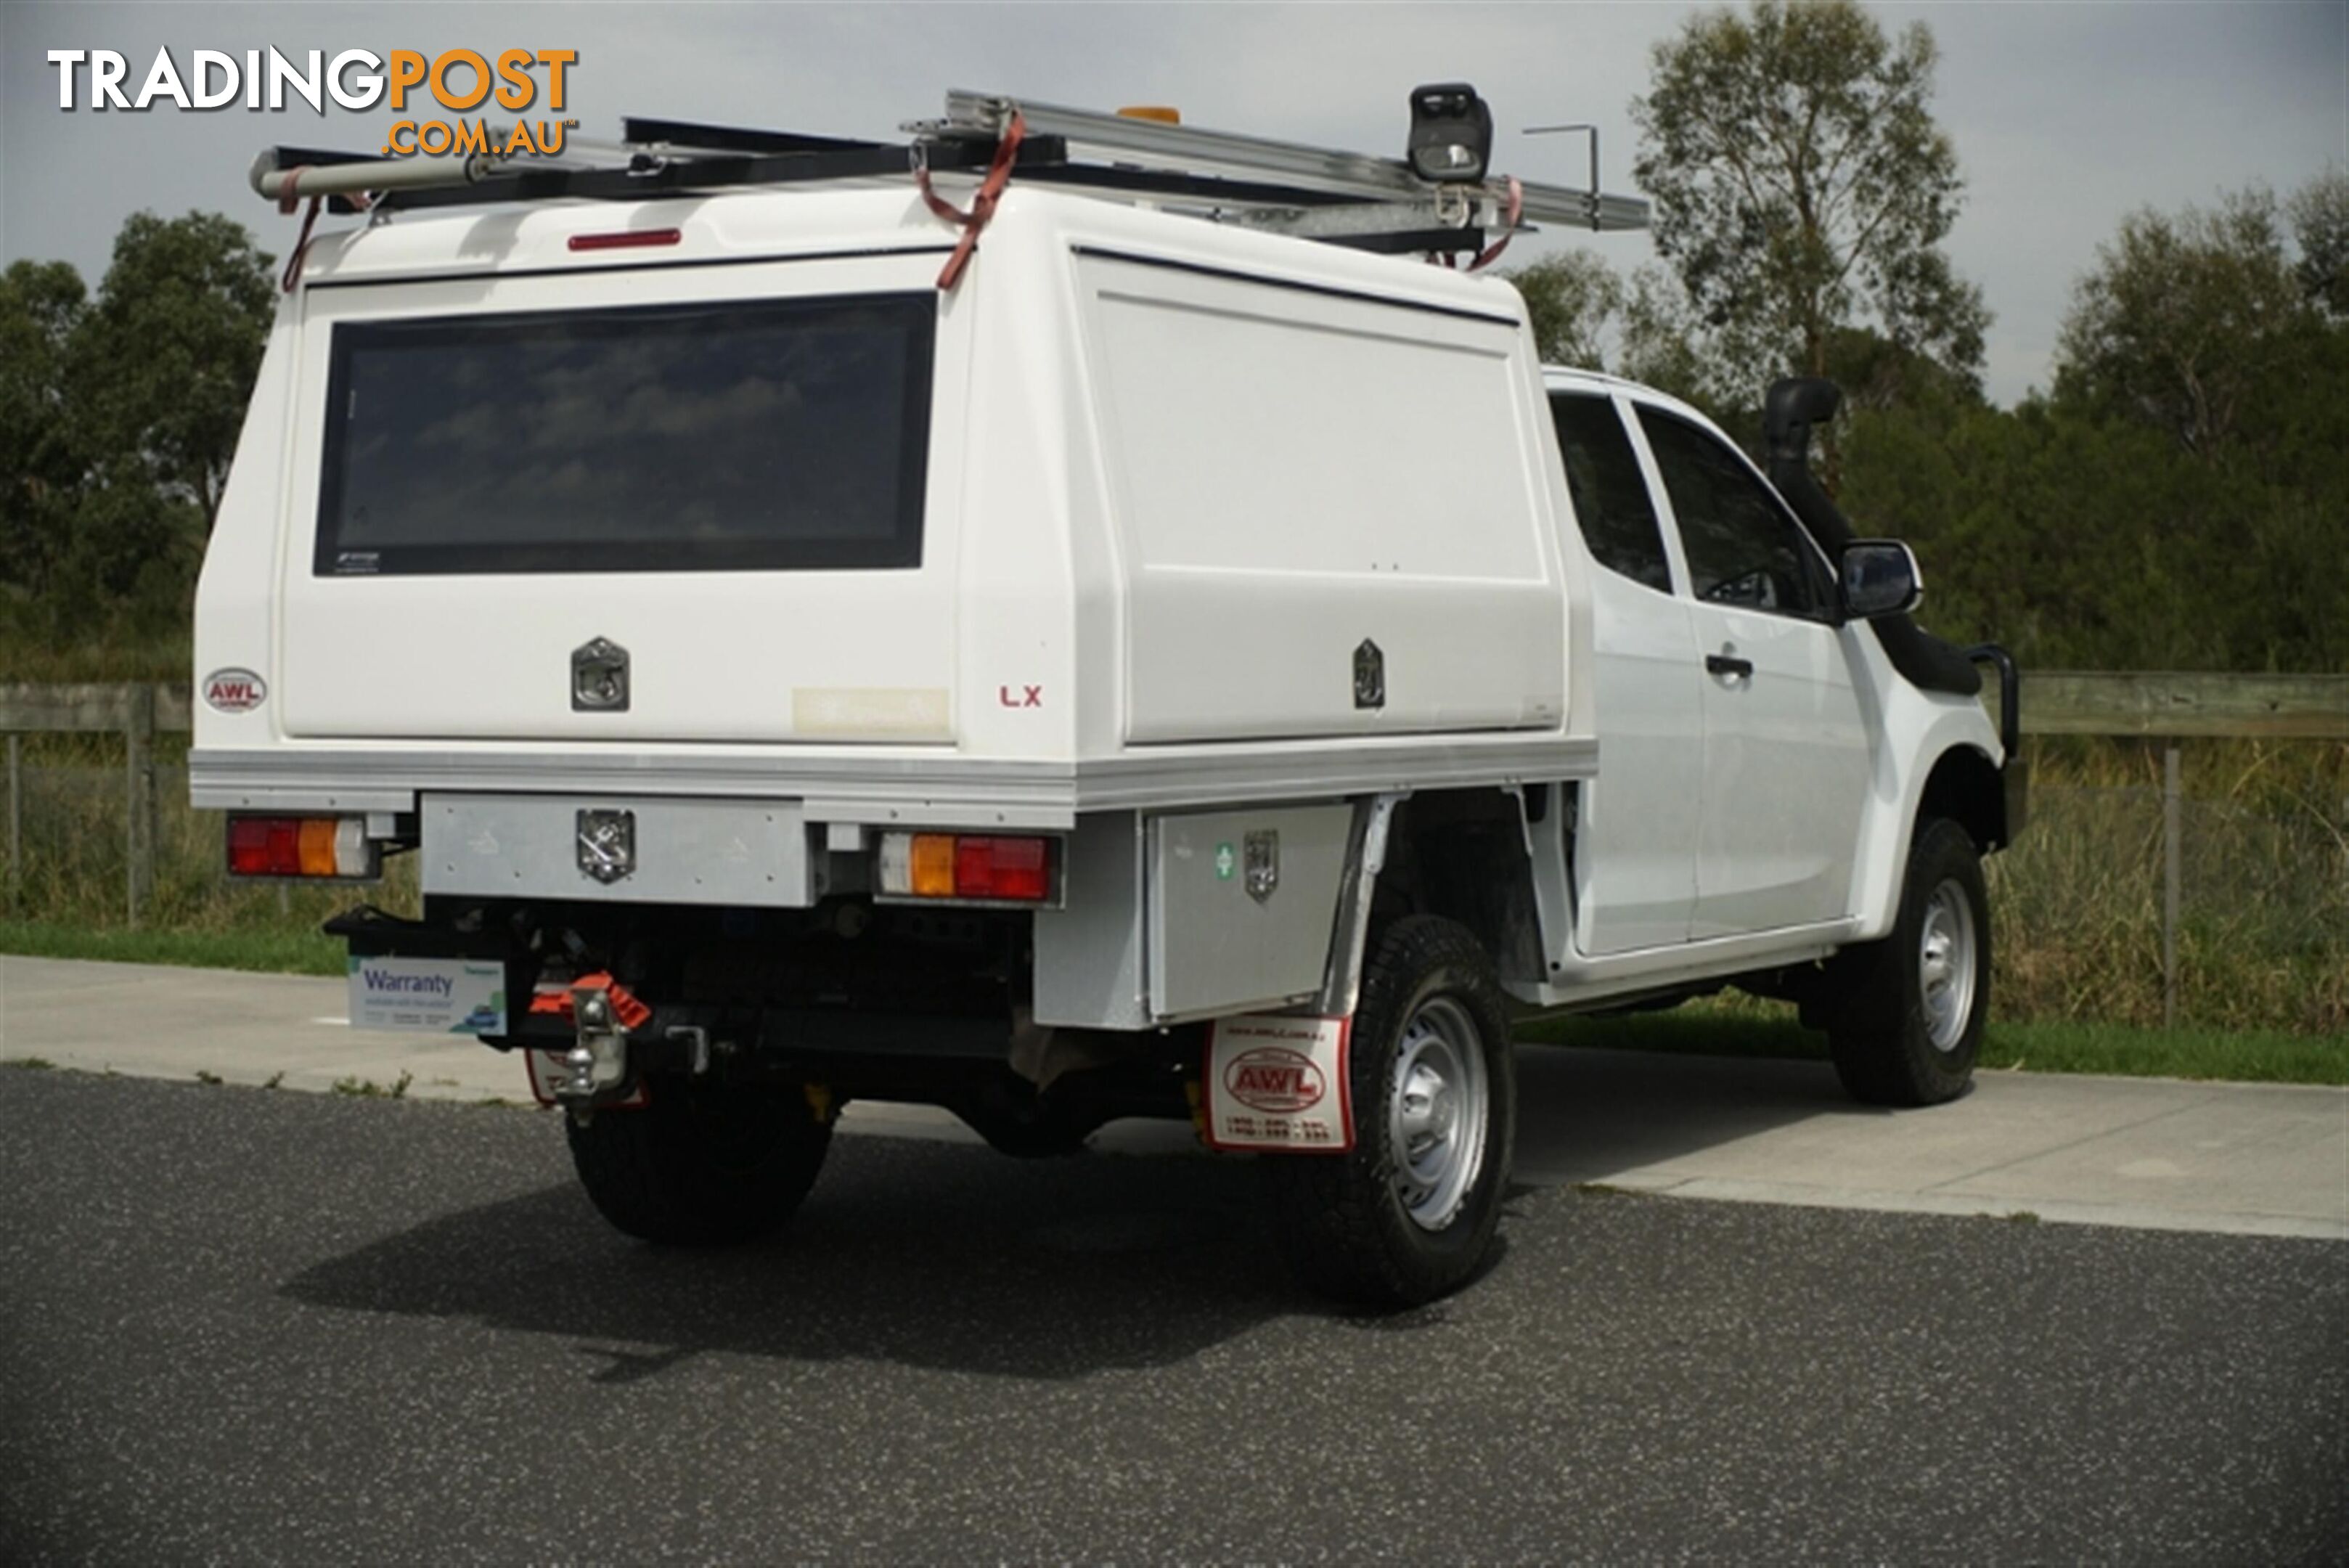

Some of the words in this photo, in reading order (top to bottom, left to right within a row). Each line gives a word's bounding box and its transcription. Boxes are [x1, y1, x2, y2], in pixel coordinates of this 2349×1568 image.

[208, 682, 260, 699] AWL
[1000, 685, 1042, 707] LX
[364, 968, 454, 997] Warranty
[1234, 1065, 1317, 1095] AWL
